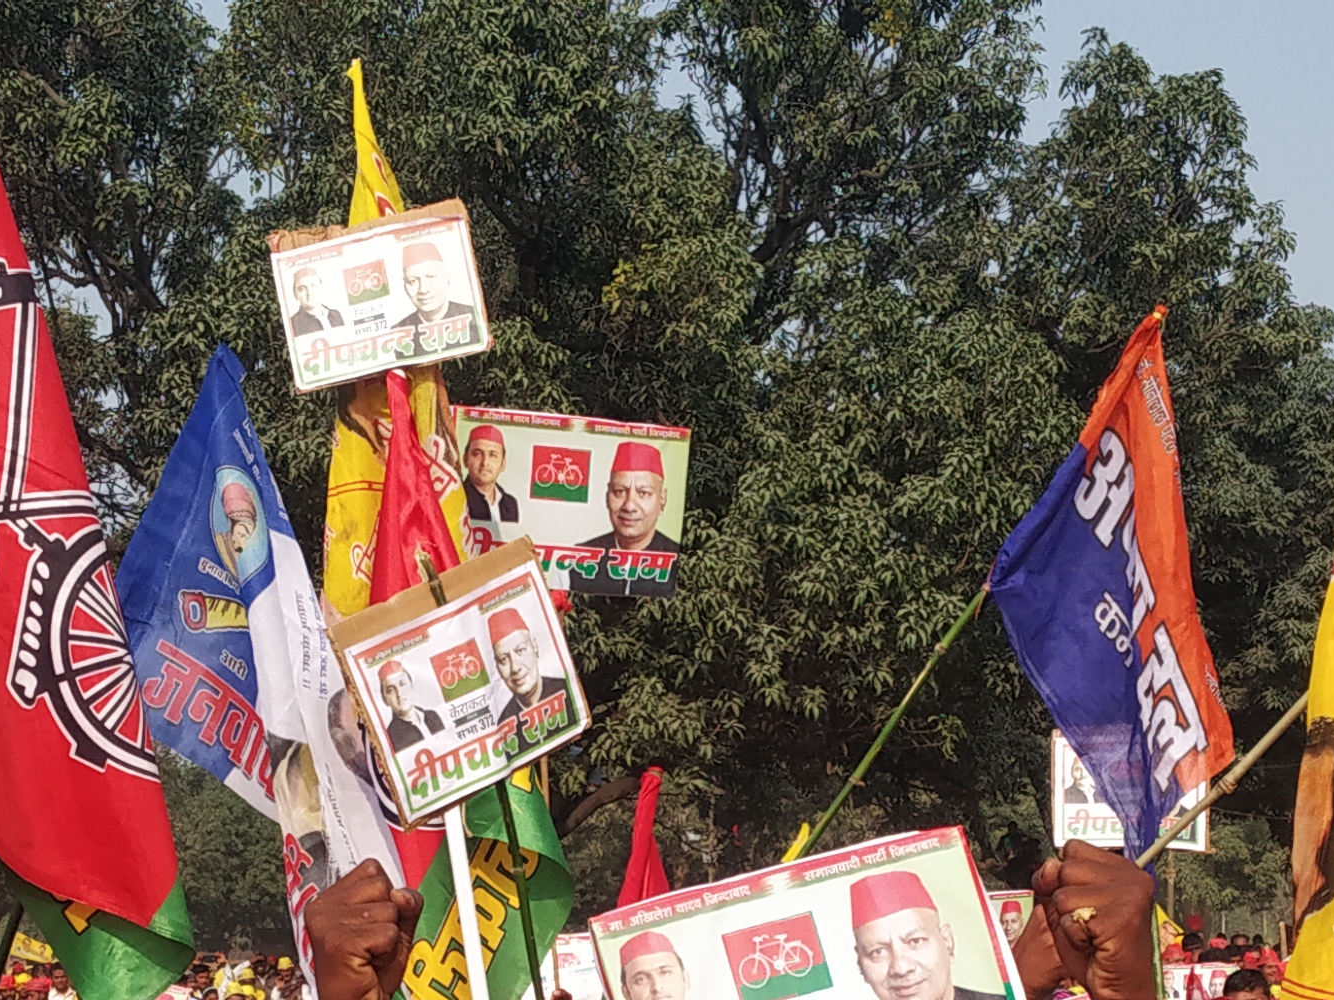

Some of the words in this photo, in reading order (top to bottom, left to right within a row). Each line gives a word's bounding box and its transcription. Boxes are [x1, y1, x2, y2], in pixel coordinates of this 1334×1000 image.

[374, 320, 389, 333] 372
[419, 313, 472, 353] राम
[607, 549, 677, 581] राम
[407, 715, 517, 799] दीपचन्द
[519, 690, 567, 745] राम
[455, 723, 479, 740] सभा
[480, 714, 497, 731] 372
[802, 854, 861, 883] समाजवादी
[863, 847, 888, 868] पार्टी
[890, 835, 941, 860] जिन्दाबाद
[627, 908, 673, 930] अखिलेश
[675, 899, 703, 917] यादव
[703, 885, 752, 909] जिन्दाबाद
